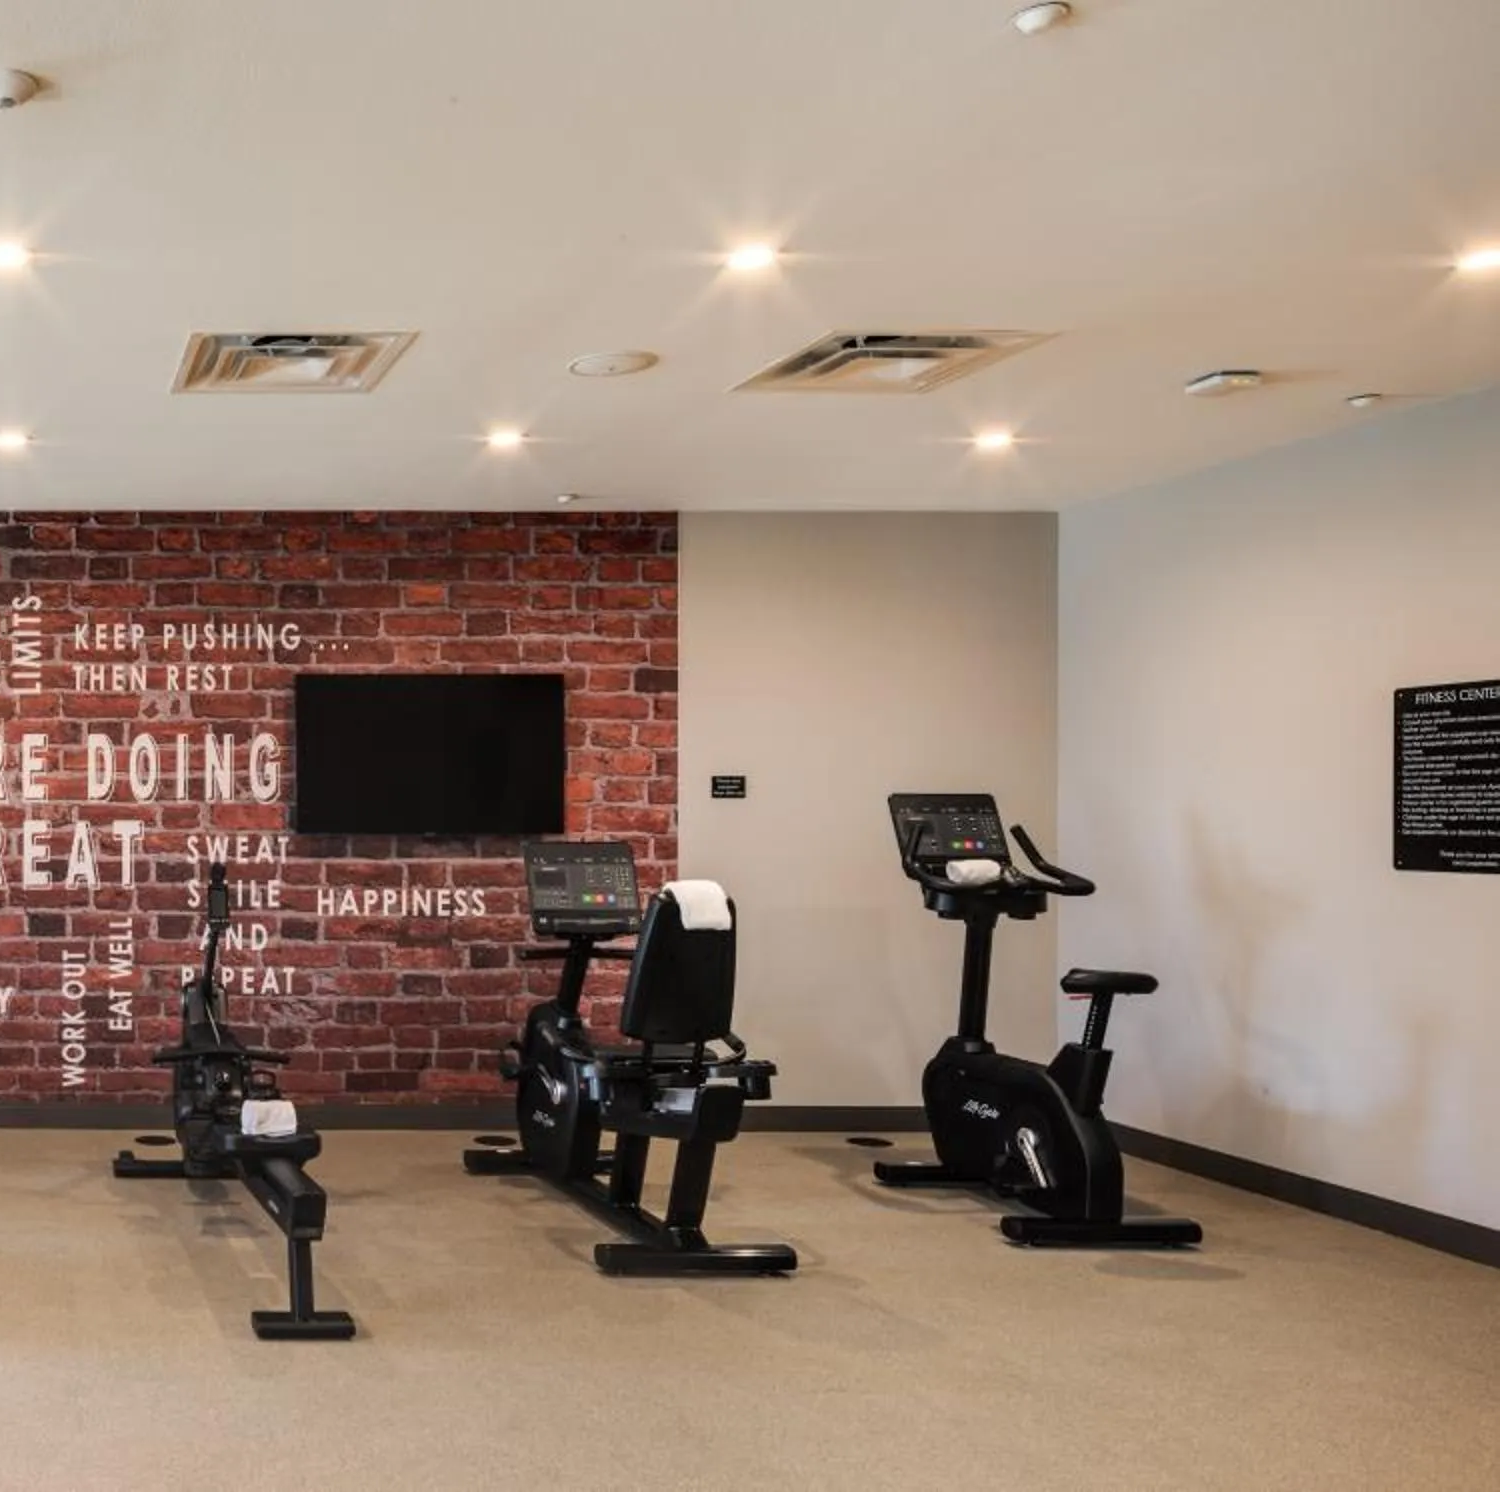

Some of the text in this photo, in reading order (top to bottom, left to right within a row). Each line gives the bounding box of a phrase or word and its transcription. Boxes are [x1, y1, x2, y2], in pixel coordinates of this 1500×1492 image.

[13, 595, 41, 694] LIMITS
[74, 624, 144, 650] KEEP
[163, 623, 301, 650] PUSHING
[73, 665, 233, 691] THEN REST
[1415, 690, 1456, 704] FITNESS
[88, 733, 281, 801] DOING
[186, 835, 290, 865] SWEAT
[187, 879, 281, 908] SILE
[316, 887, 486, 917] HAPPINESS
[109, 917, 133, 1030] EAT WELL
[181, 966, 296, 995] RPEAT
[62, 950, 86, 1087] WORK OUT
